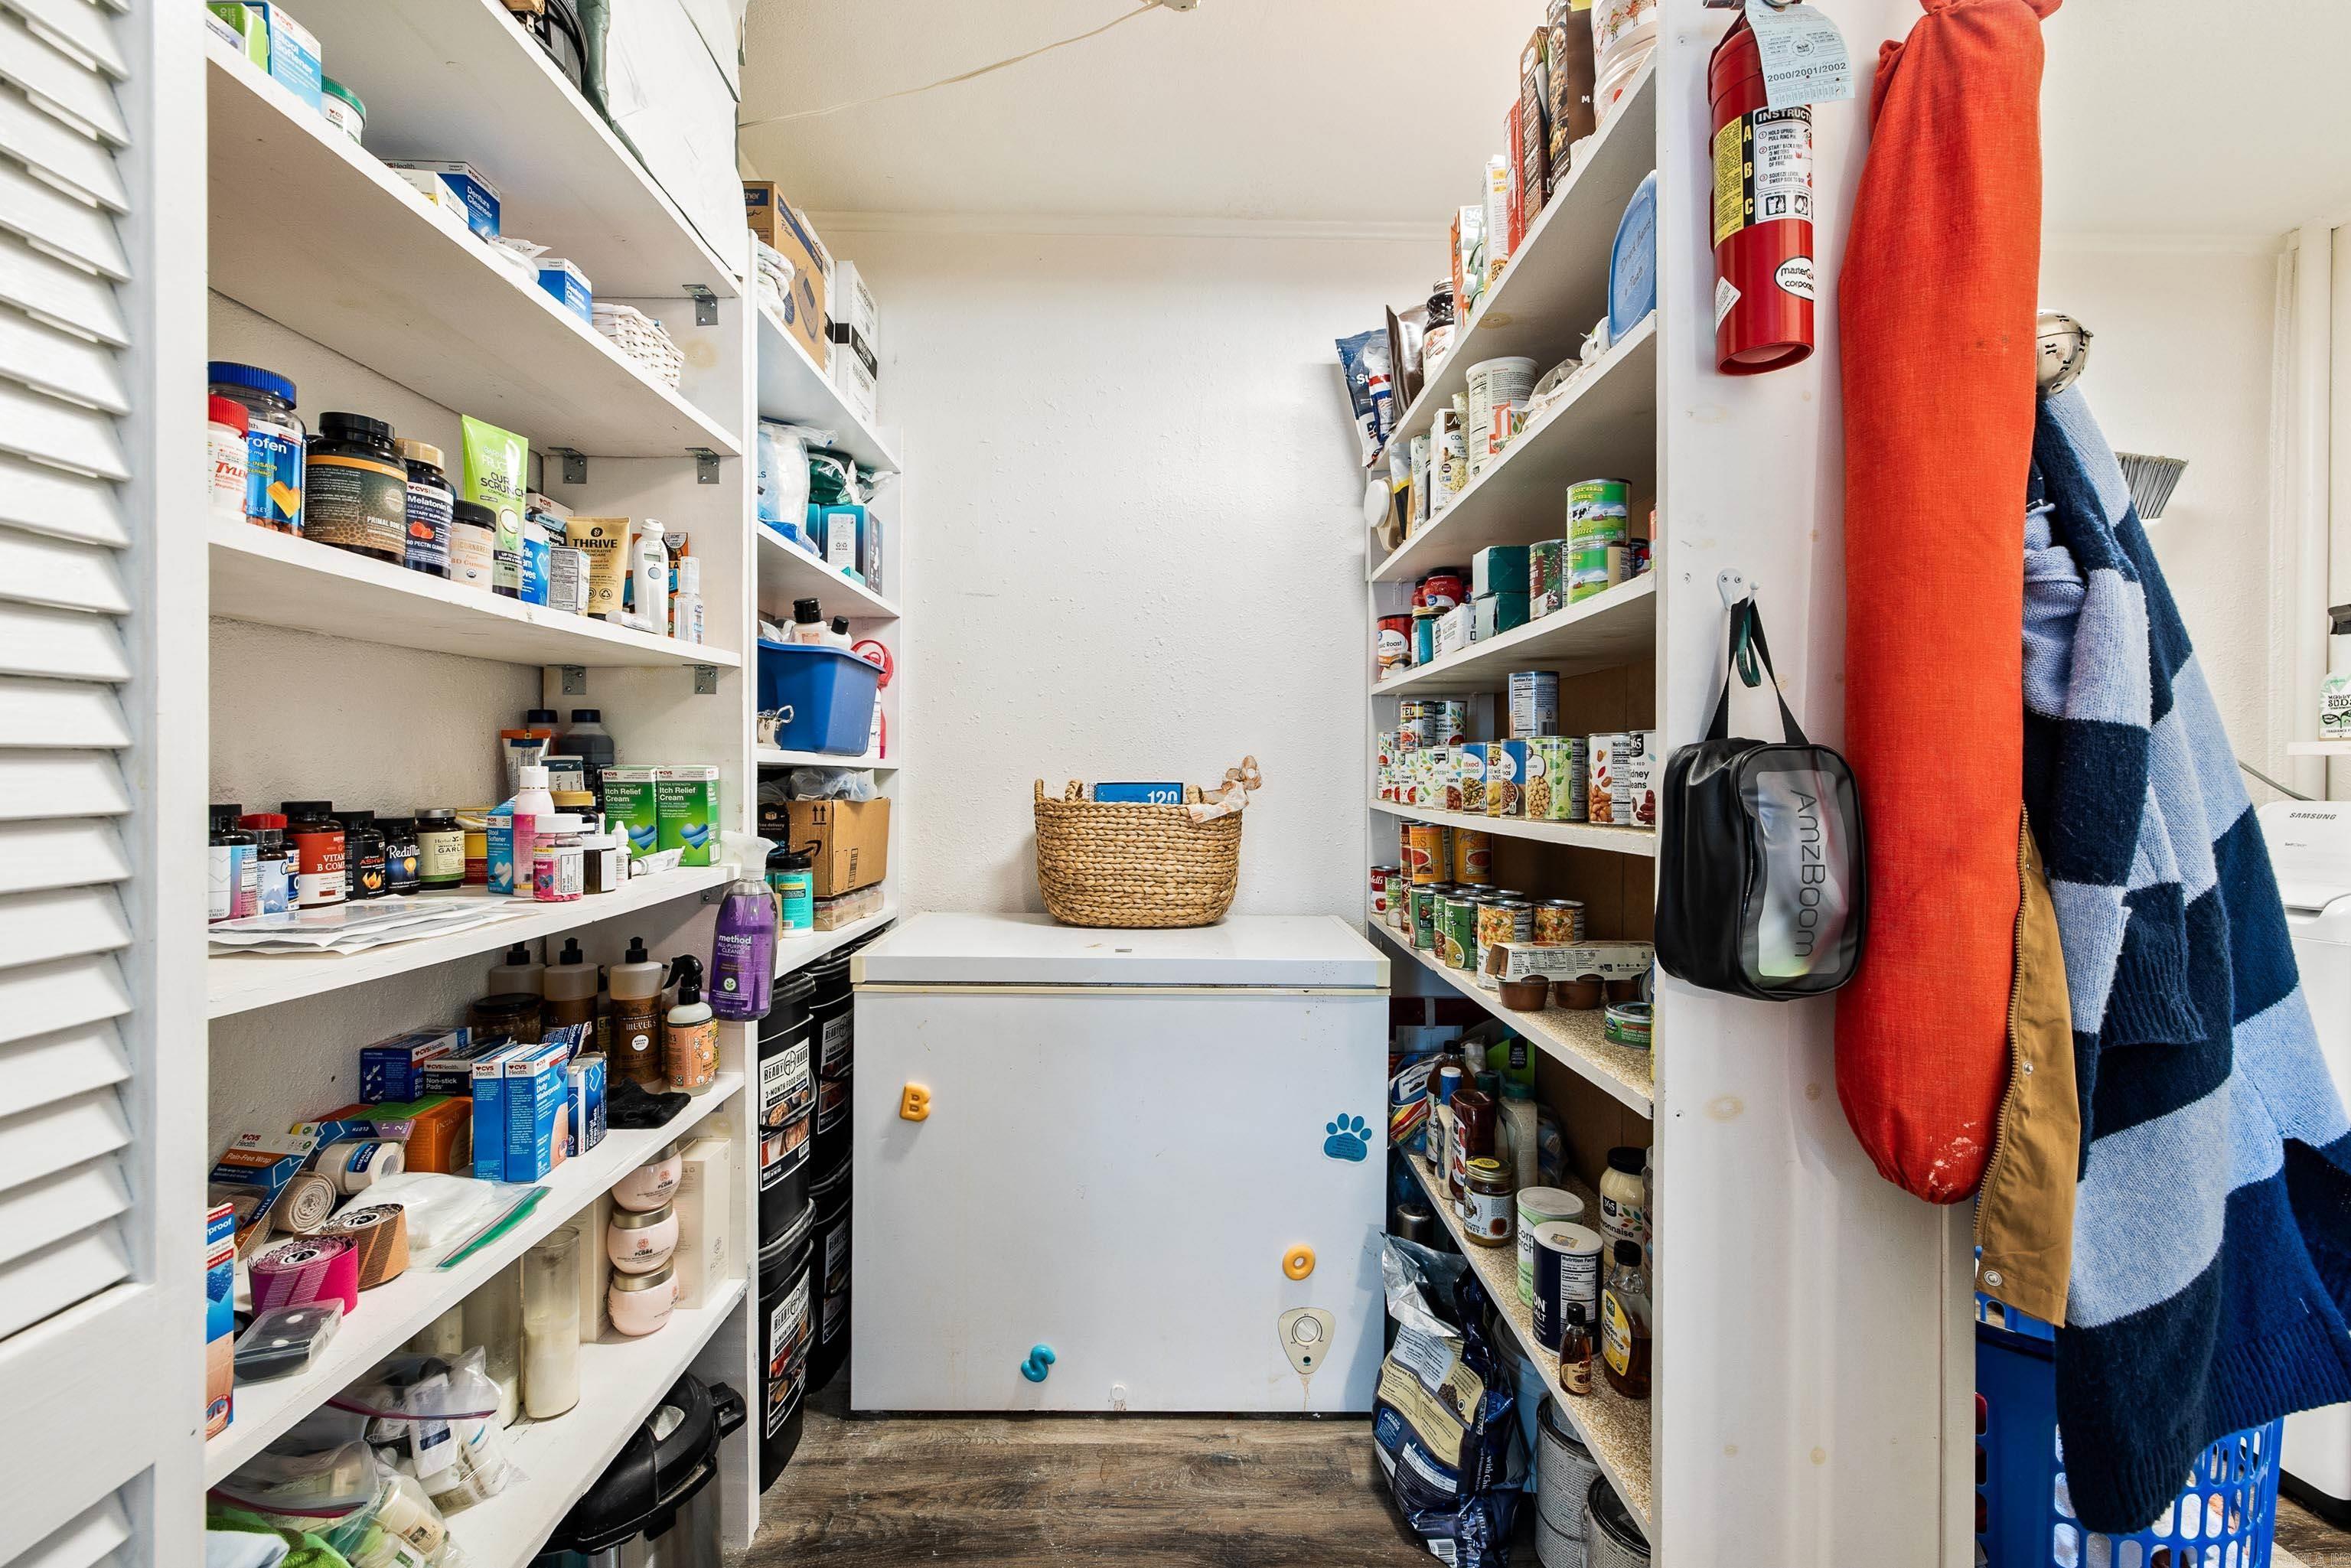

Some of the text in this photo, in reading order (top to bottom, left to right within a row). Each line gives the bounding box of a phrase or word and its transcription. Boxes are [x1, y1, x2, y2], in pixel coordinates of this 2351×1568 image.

[274, 39, 314, 74] Softener
[1767, 62, 1847, 83] 2000/2001/2002
[1743, 125, 1753, 143] A
[1744, 161, 1753, 179] B
[467, 186, 491, 210] Denture
[1745, 197, 1754, 215] C
[467, 194, 493, 220] Cleanser
[215, 461, 247, 479] TYLEN
[407, 494, 447, 510] Melatonin
[542, 499, 552, 508] CVS
[367, 516, 389, 526] PRIMAL
[406, 508, 429, 517] DIETARY
[572, 538, 618, 549] THRIVE
[2289, 812, 2337, 820] SAMSUNG
[386, 844, 421, 859] RediMin
[316, 863, 323, 872] B
[1789, 789, 1826, 957] AmzBoom
[718, 942, 751, 951] ALL-PURPOSE
[719, 934, 752, 945] method
[722, 947, 745, 956] CLEANER
[420, 1046, 431, 1056] CVS
[764, 1048, 808, 1081] READY HOUR
[536, 1072, 551, 1087] Heavy
[765, 1082, 786, 1099] 3-MONTH
[786, 1077, 796, 1087] FOOD
[796, 1068, 808, 1083] SUPPLY
[536, 1084, 549, 1095] Duty
[536, 1083, 562, 1102] Waterproof
[898, 1081, 931, 1123] B
[236, 1139, 256, 1148] Health
[227, 1152, 272, 1164] Pain-Free Wrap
[356, 1144, 375, 1171] RESEALABLE
[364, 1150, 373, 1163] CASE
[253, 1198, 272, 1221] GENTLE
[1603, 1198, 1615, 1211] 365
[1282, 1244, 1316, 1282] O
[1020, 1343, 1056, 1382] S
[1476, 1507, 1487, 1536] ADULT
